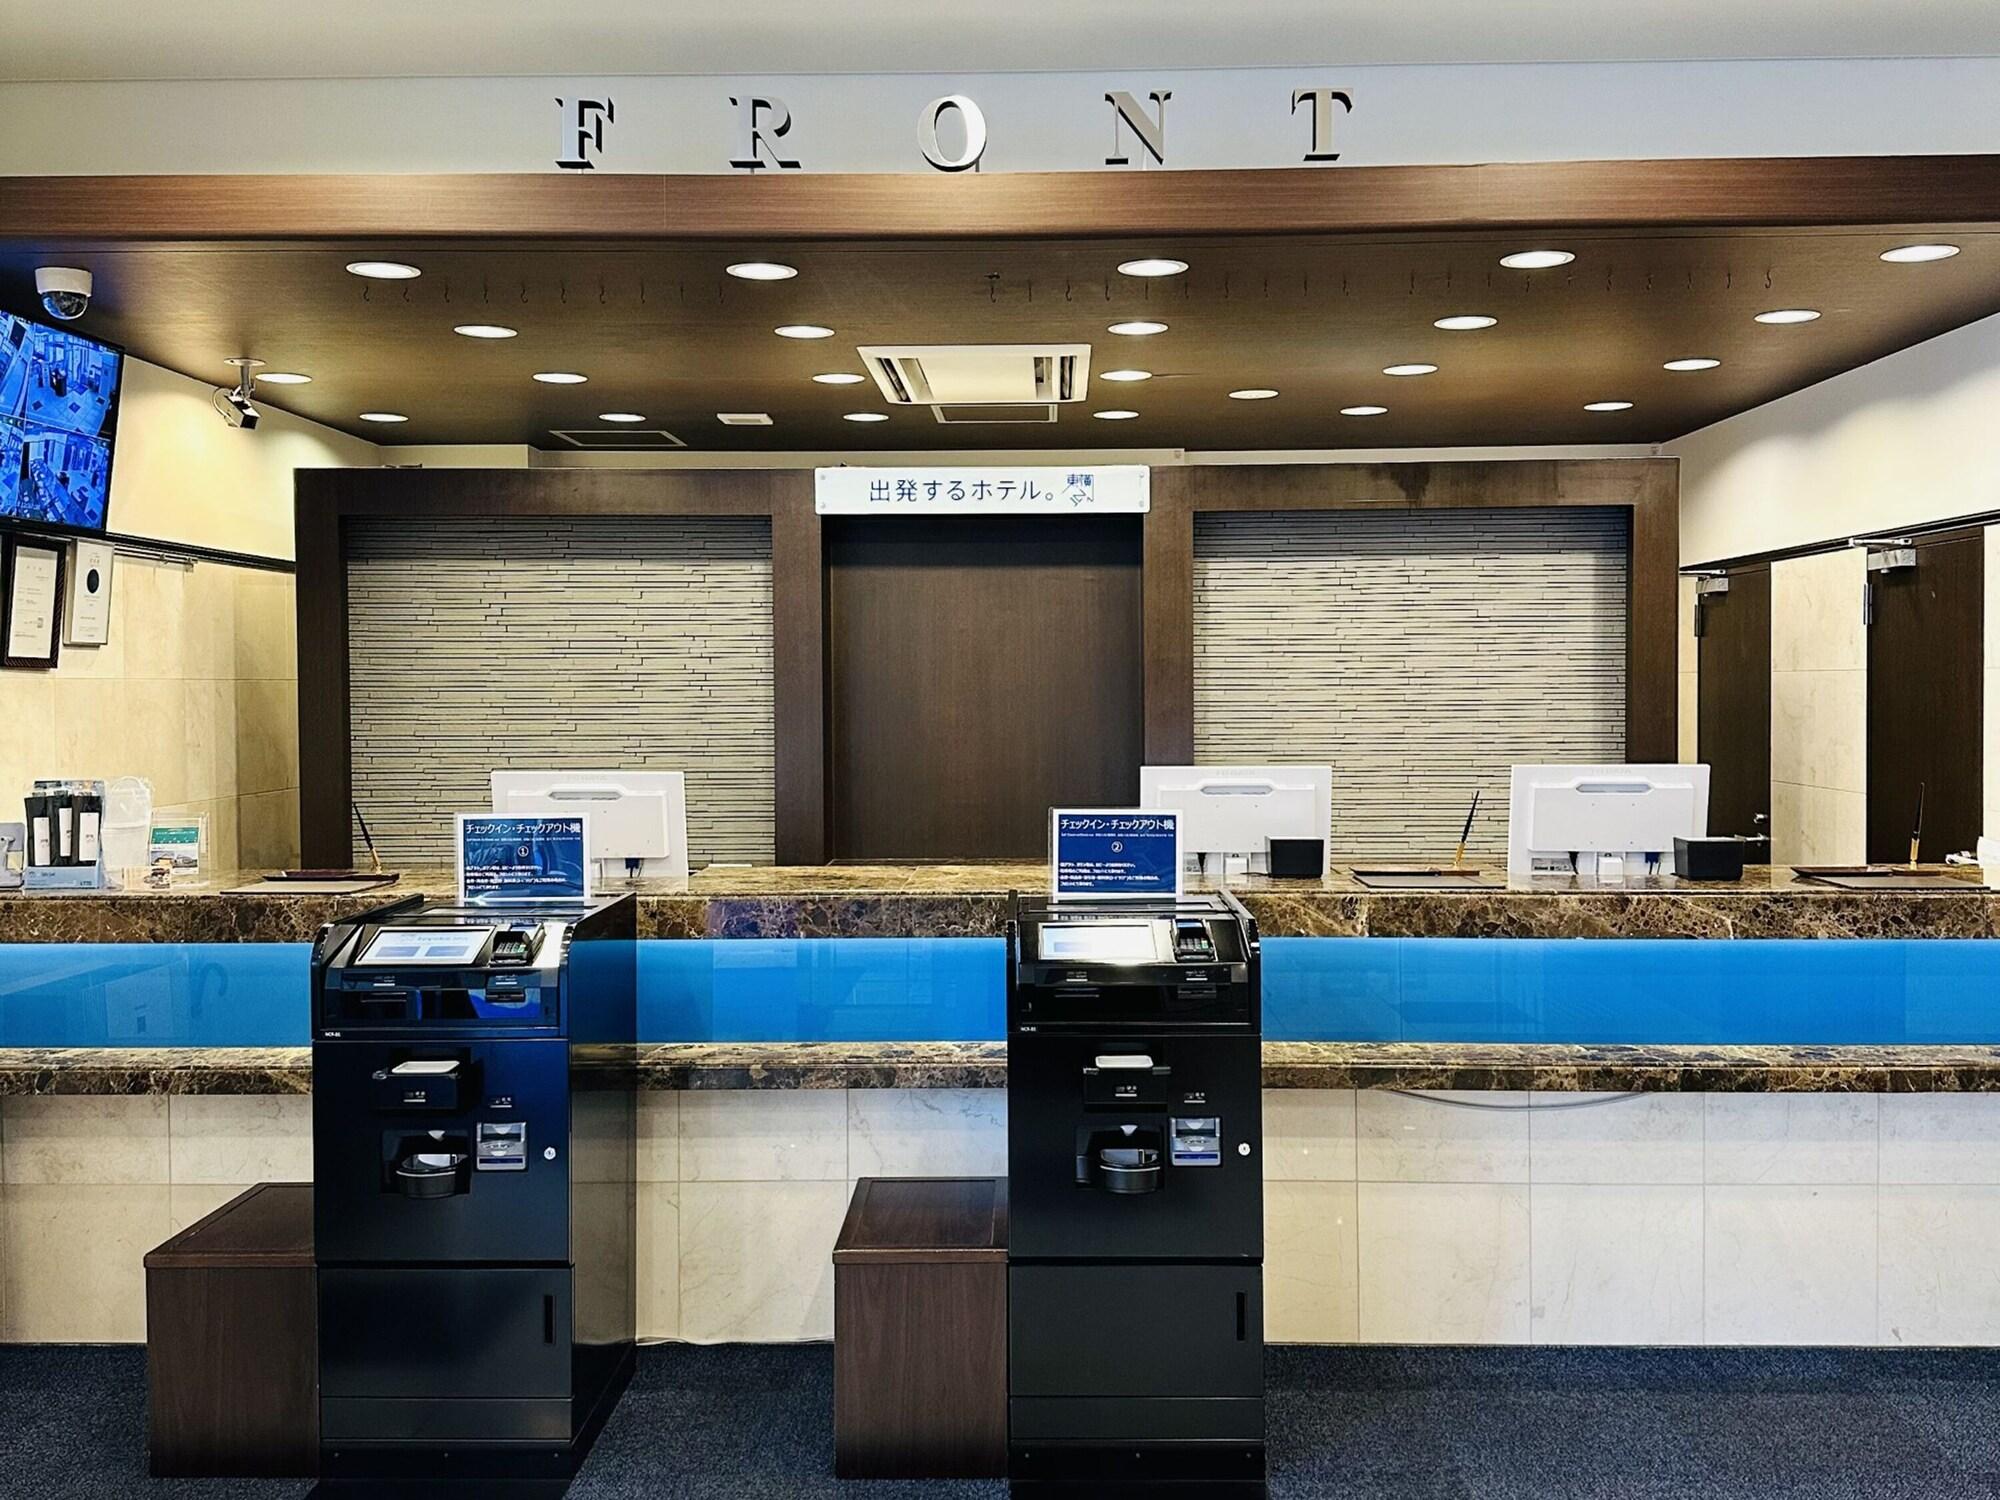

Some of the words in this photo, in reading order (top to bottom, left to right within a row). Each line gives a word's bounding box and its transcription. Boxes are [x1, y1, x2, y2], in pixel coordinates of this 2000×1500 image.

[555, 86, 1353, 171] FRONT
[870, 479, 1054, 502] 出発するホテル。
[465, 823, 581, 834] チェックイン・チェックアウト機
[1060, 819, 1175, 830] チェックイン・チェックアウト機
